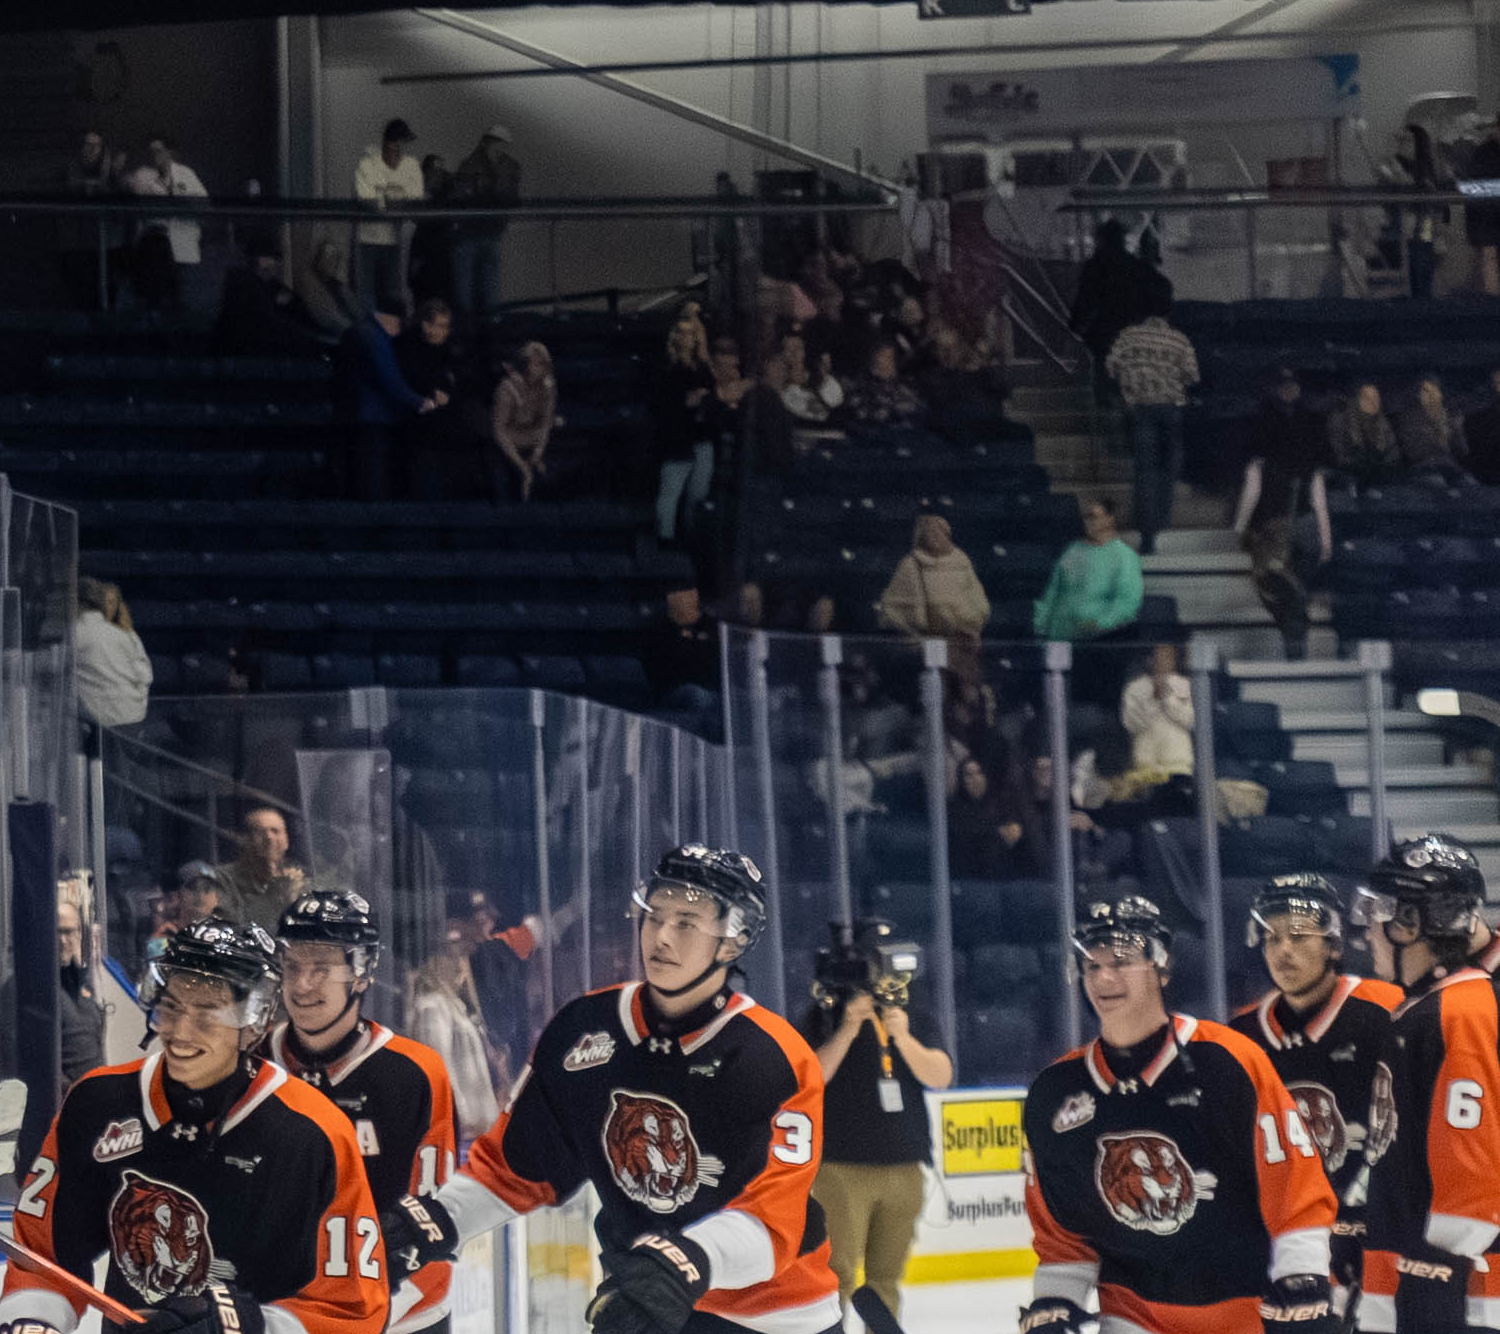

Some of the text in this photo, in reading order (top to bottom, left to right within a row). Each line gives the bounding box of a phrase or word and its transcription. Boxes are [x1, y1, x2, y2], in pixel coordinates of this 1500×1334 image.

[1446, 1078, 1484, 1130] 6
[355, 1118, 381, 1156] A
[772, 1110, 814, 1165] 3
[945, 1118, 1020, 1158] Surplus
[1259, 1109, 1316, 1164] 14
[18, 1155, 56, 1219] 2
[399, 1194, 445, 1244] UER
[323, 1216, 380, 1279] 12
[1396, 1256, 1453, 1283] UER
